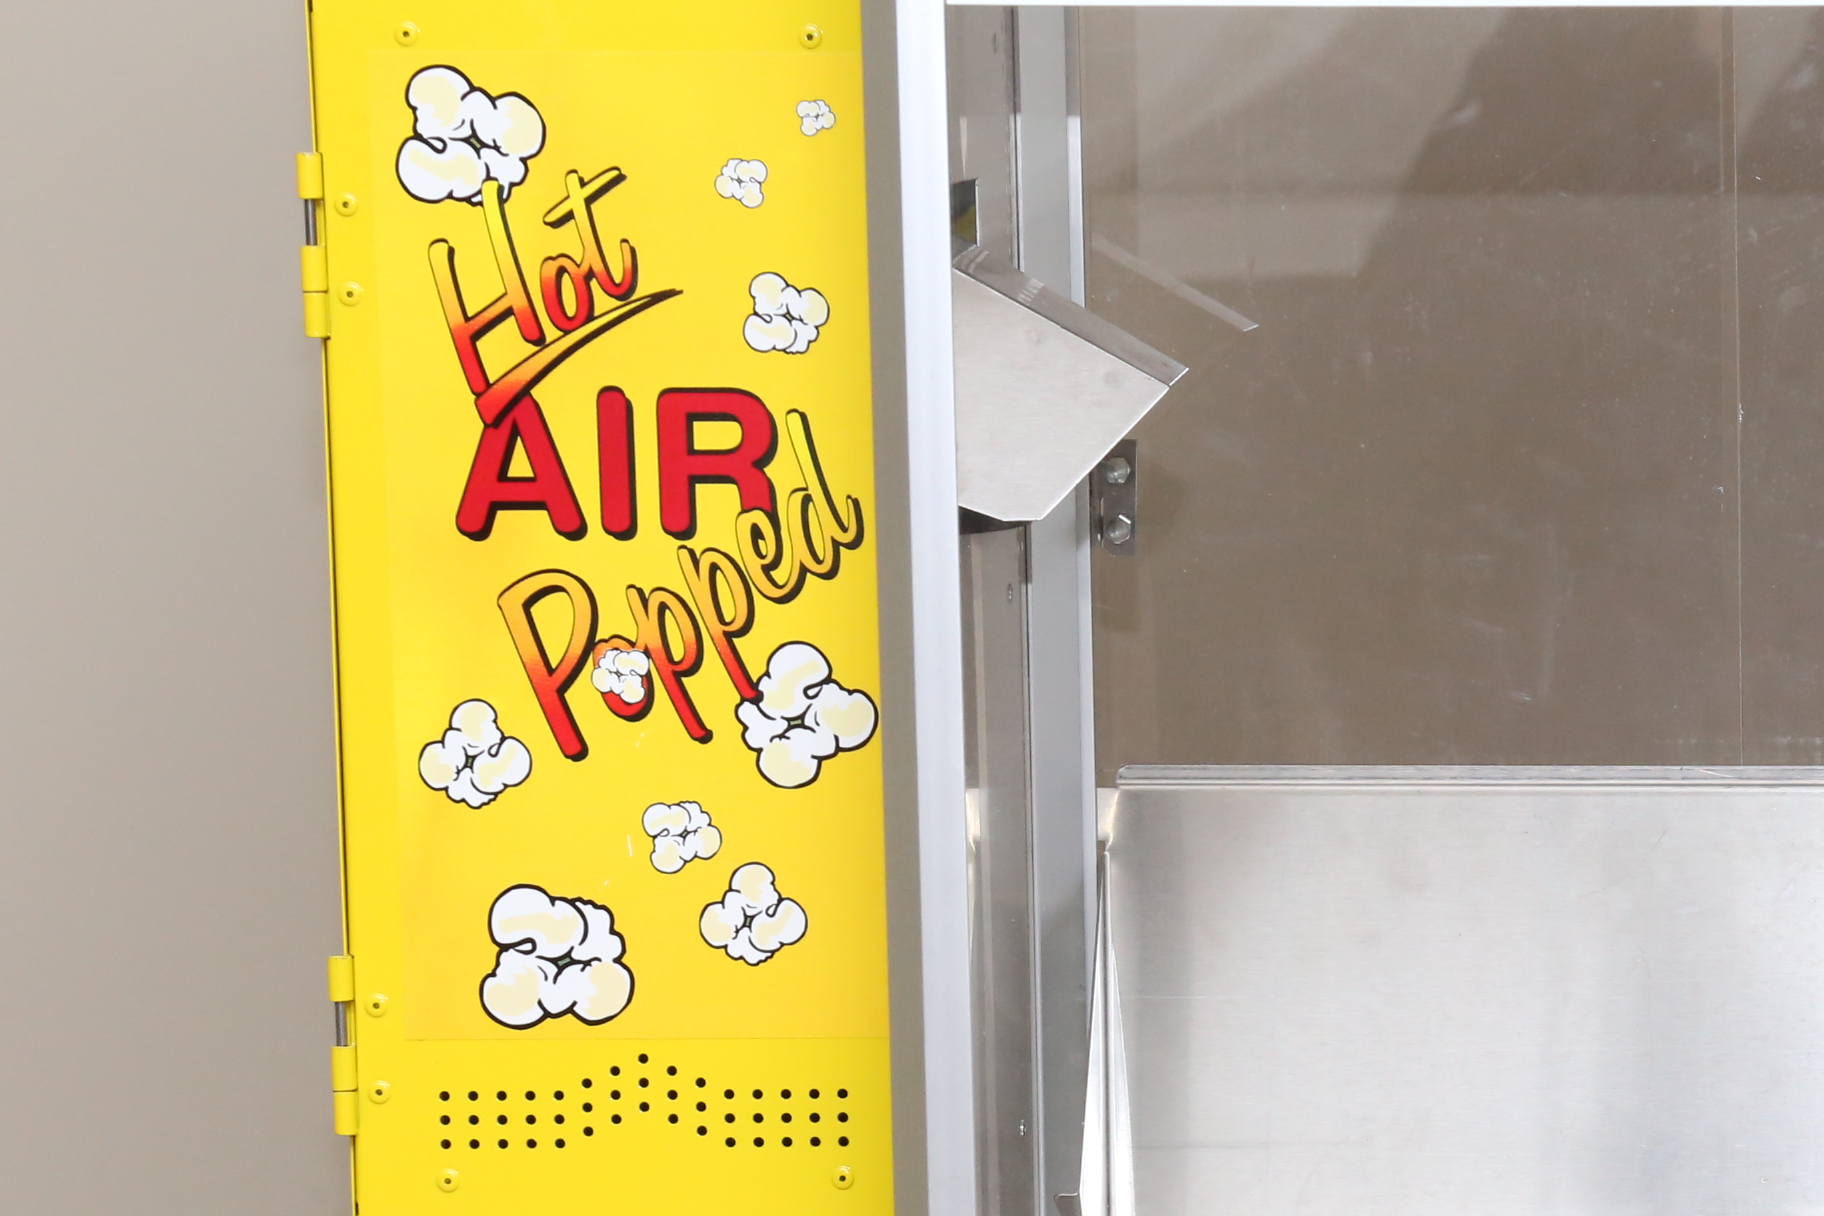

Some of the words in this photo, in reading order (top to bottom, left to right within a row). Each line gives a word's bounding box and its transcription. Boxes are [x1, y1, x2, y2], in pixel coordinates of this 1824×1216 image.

[428, 167, 640, 398] Hot
[455, 386, 778, 541] AIR
[497, 409, 864, 761] Popped
